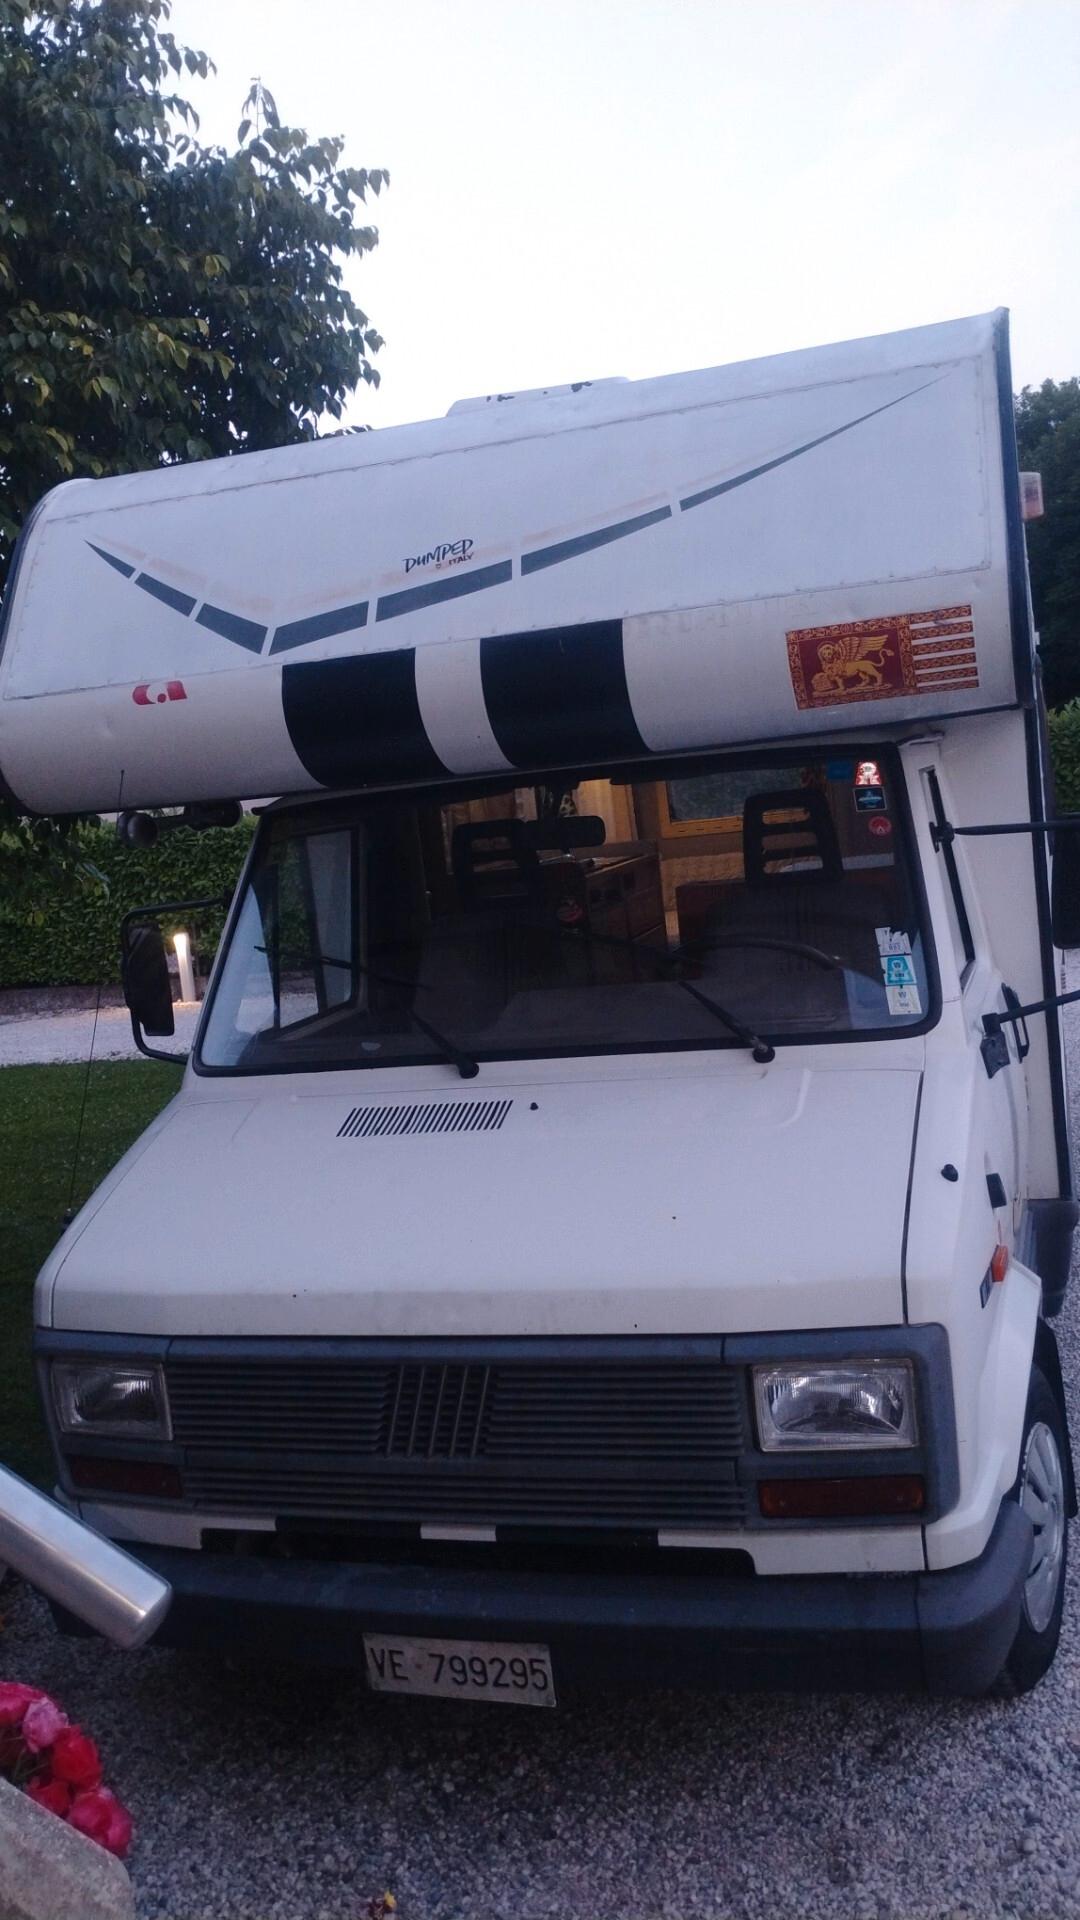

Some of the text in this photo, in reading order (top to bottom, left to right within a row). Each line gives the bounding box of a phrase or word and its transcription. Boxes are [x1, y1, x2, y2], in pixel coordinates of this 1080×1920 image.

[402, 539, 473, 573] DUMPED
[448, 552, 474, 565] ITALY
[370, 1648, 549, 1691] VE 799295
